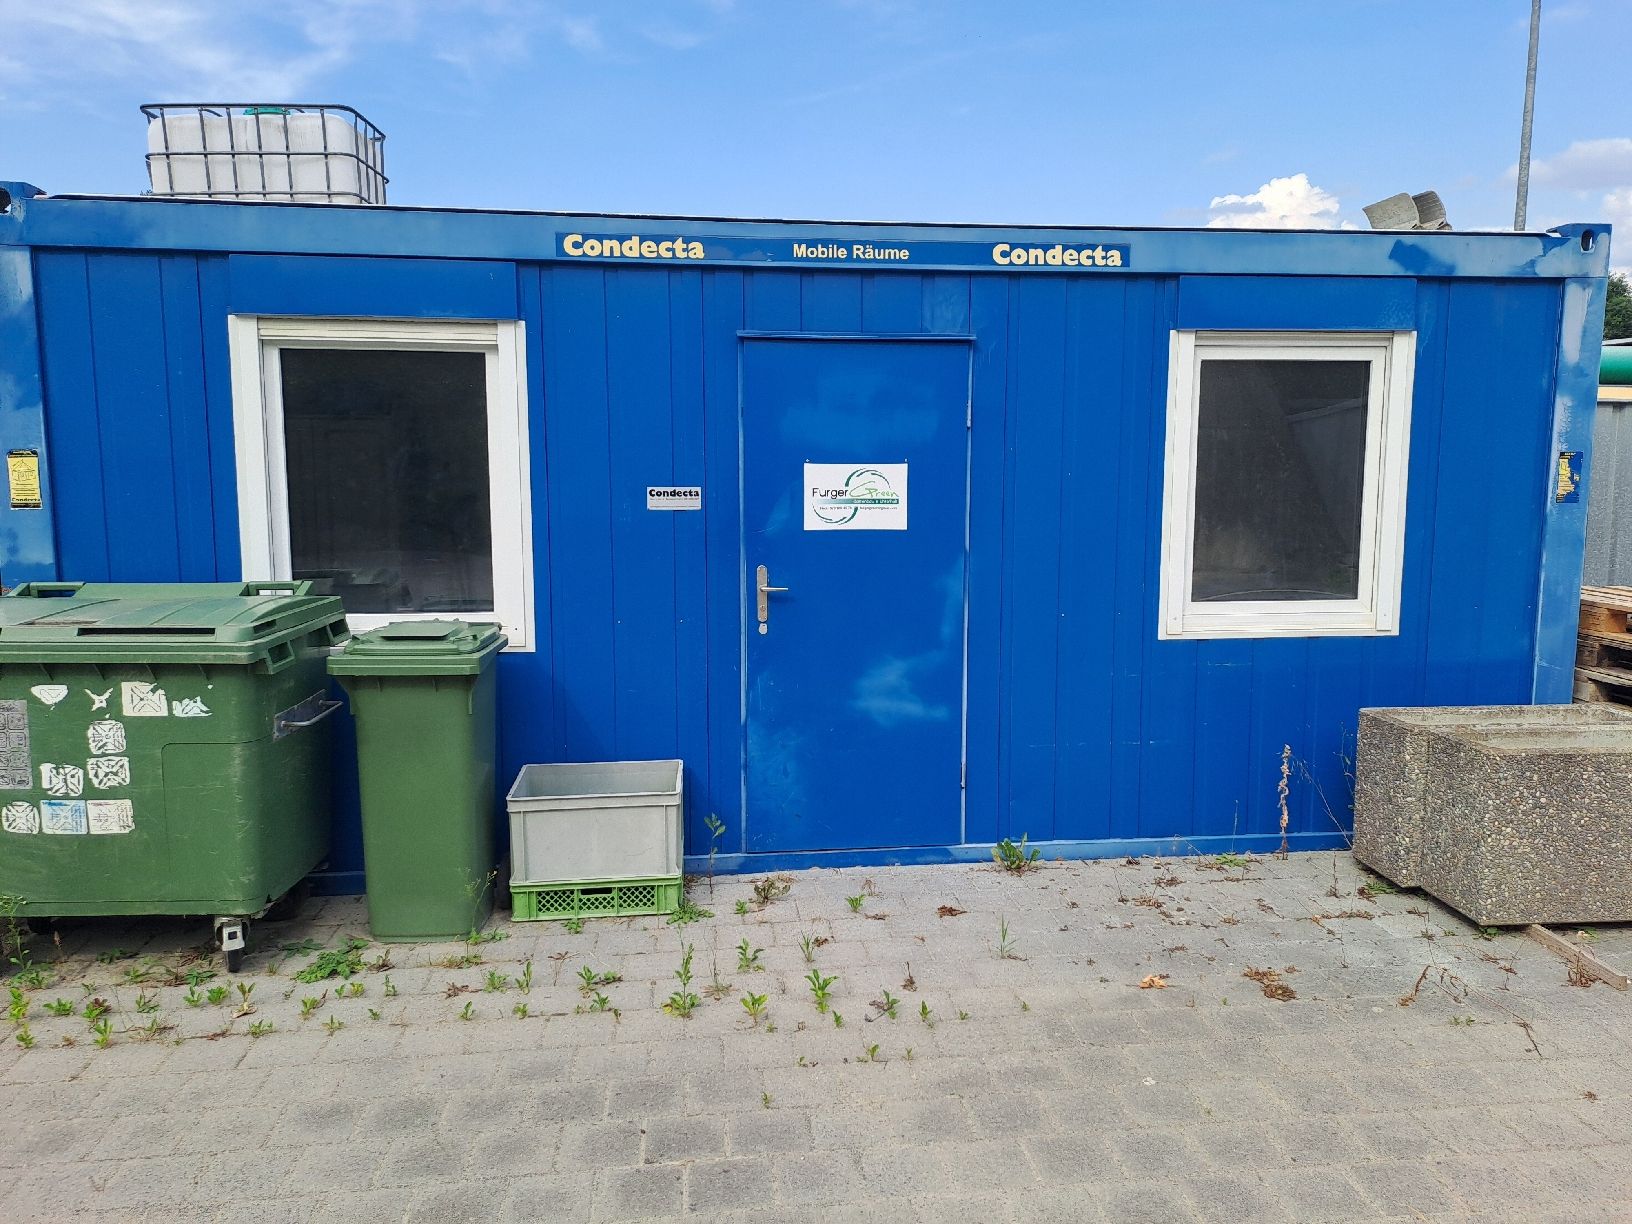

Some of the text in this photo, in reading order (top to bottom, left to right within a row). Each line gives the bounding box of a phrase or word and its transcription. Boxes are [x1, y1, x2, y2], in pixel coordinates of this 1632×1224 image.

[563, 233, 705, 259] Condecta
[793, 243, 910, 260] Mobile Räume
[992, 243, 1123, 267] Condecta
[648, 488, 700, 498] Condecta
[812, 487, 848, 499] Furger
